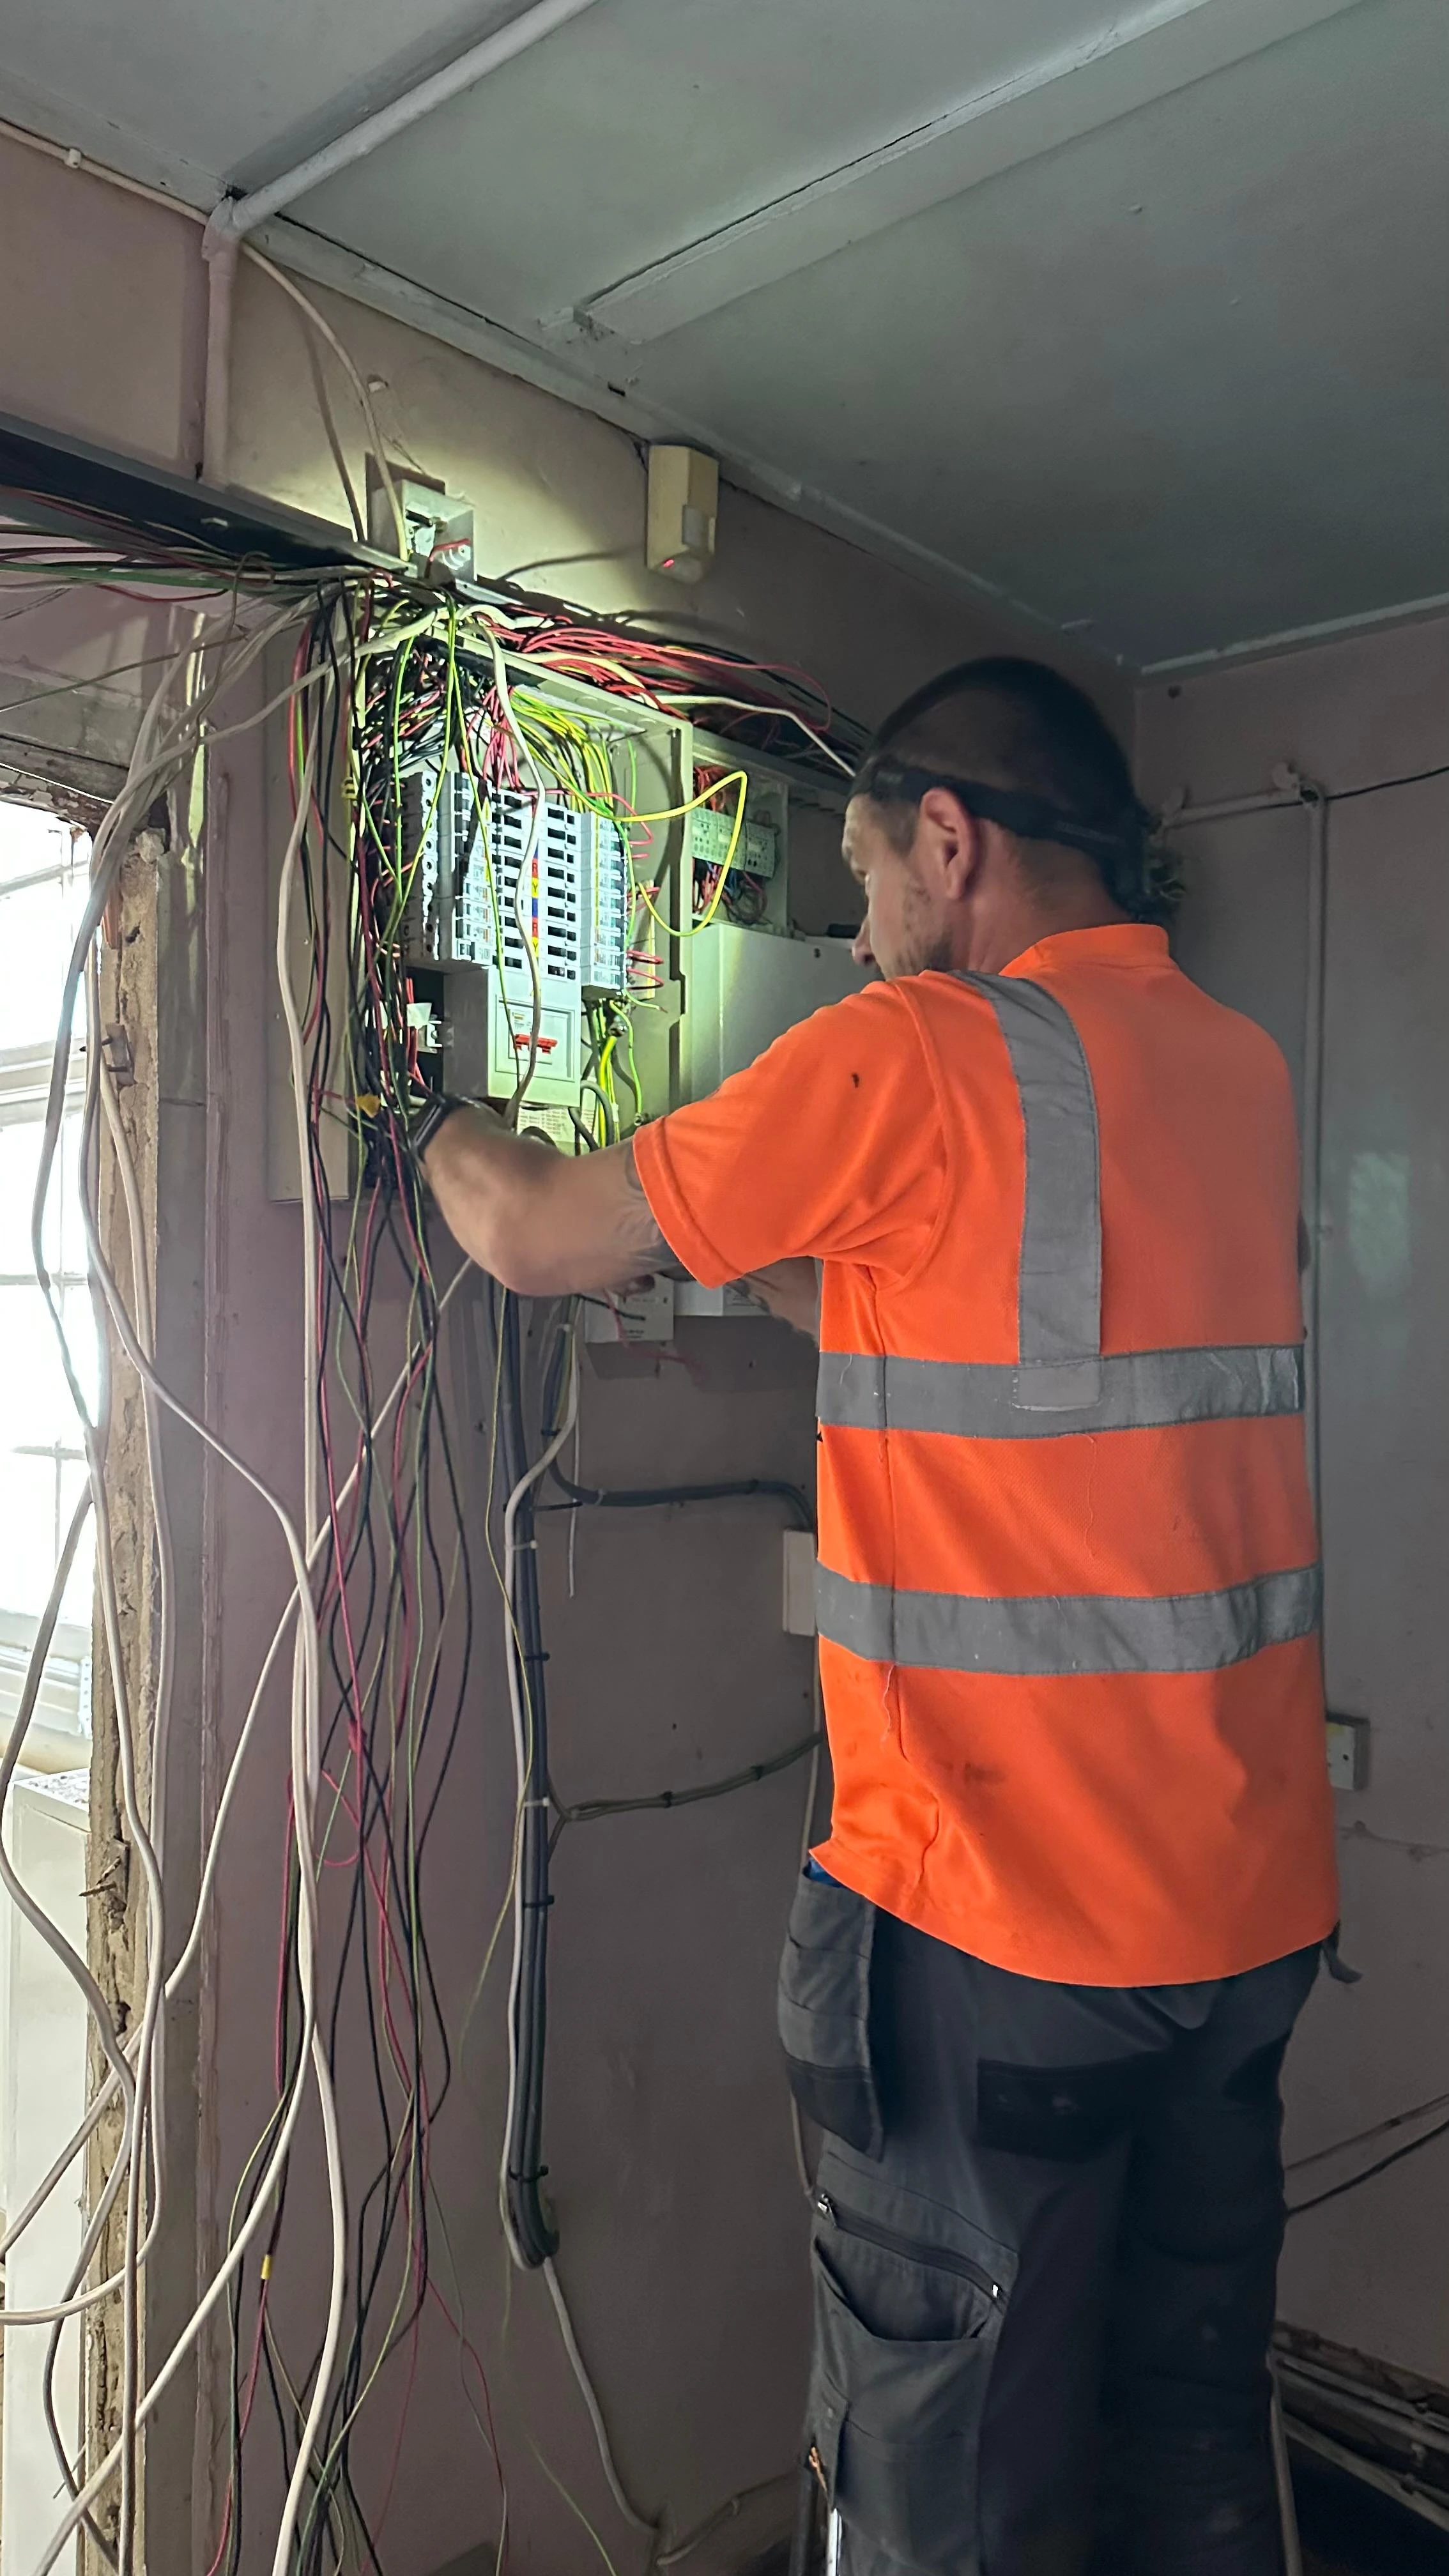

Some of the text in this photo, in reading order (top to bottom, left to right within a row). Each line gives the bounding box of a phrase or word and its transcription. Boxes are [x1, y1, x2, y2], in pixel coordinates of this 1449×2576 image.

[532, 862, 538, 873] R
[532, 882, 538, 893] Y
[532, 923, 538, 933] R
[533, 942, 538, 952] Y
